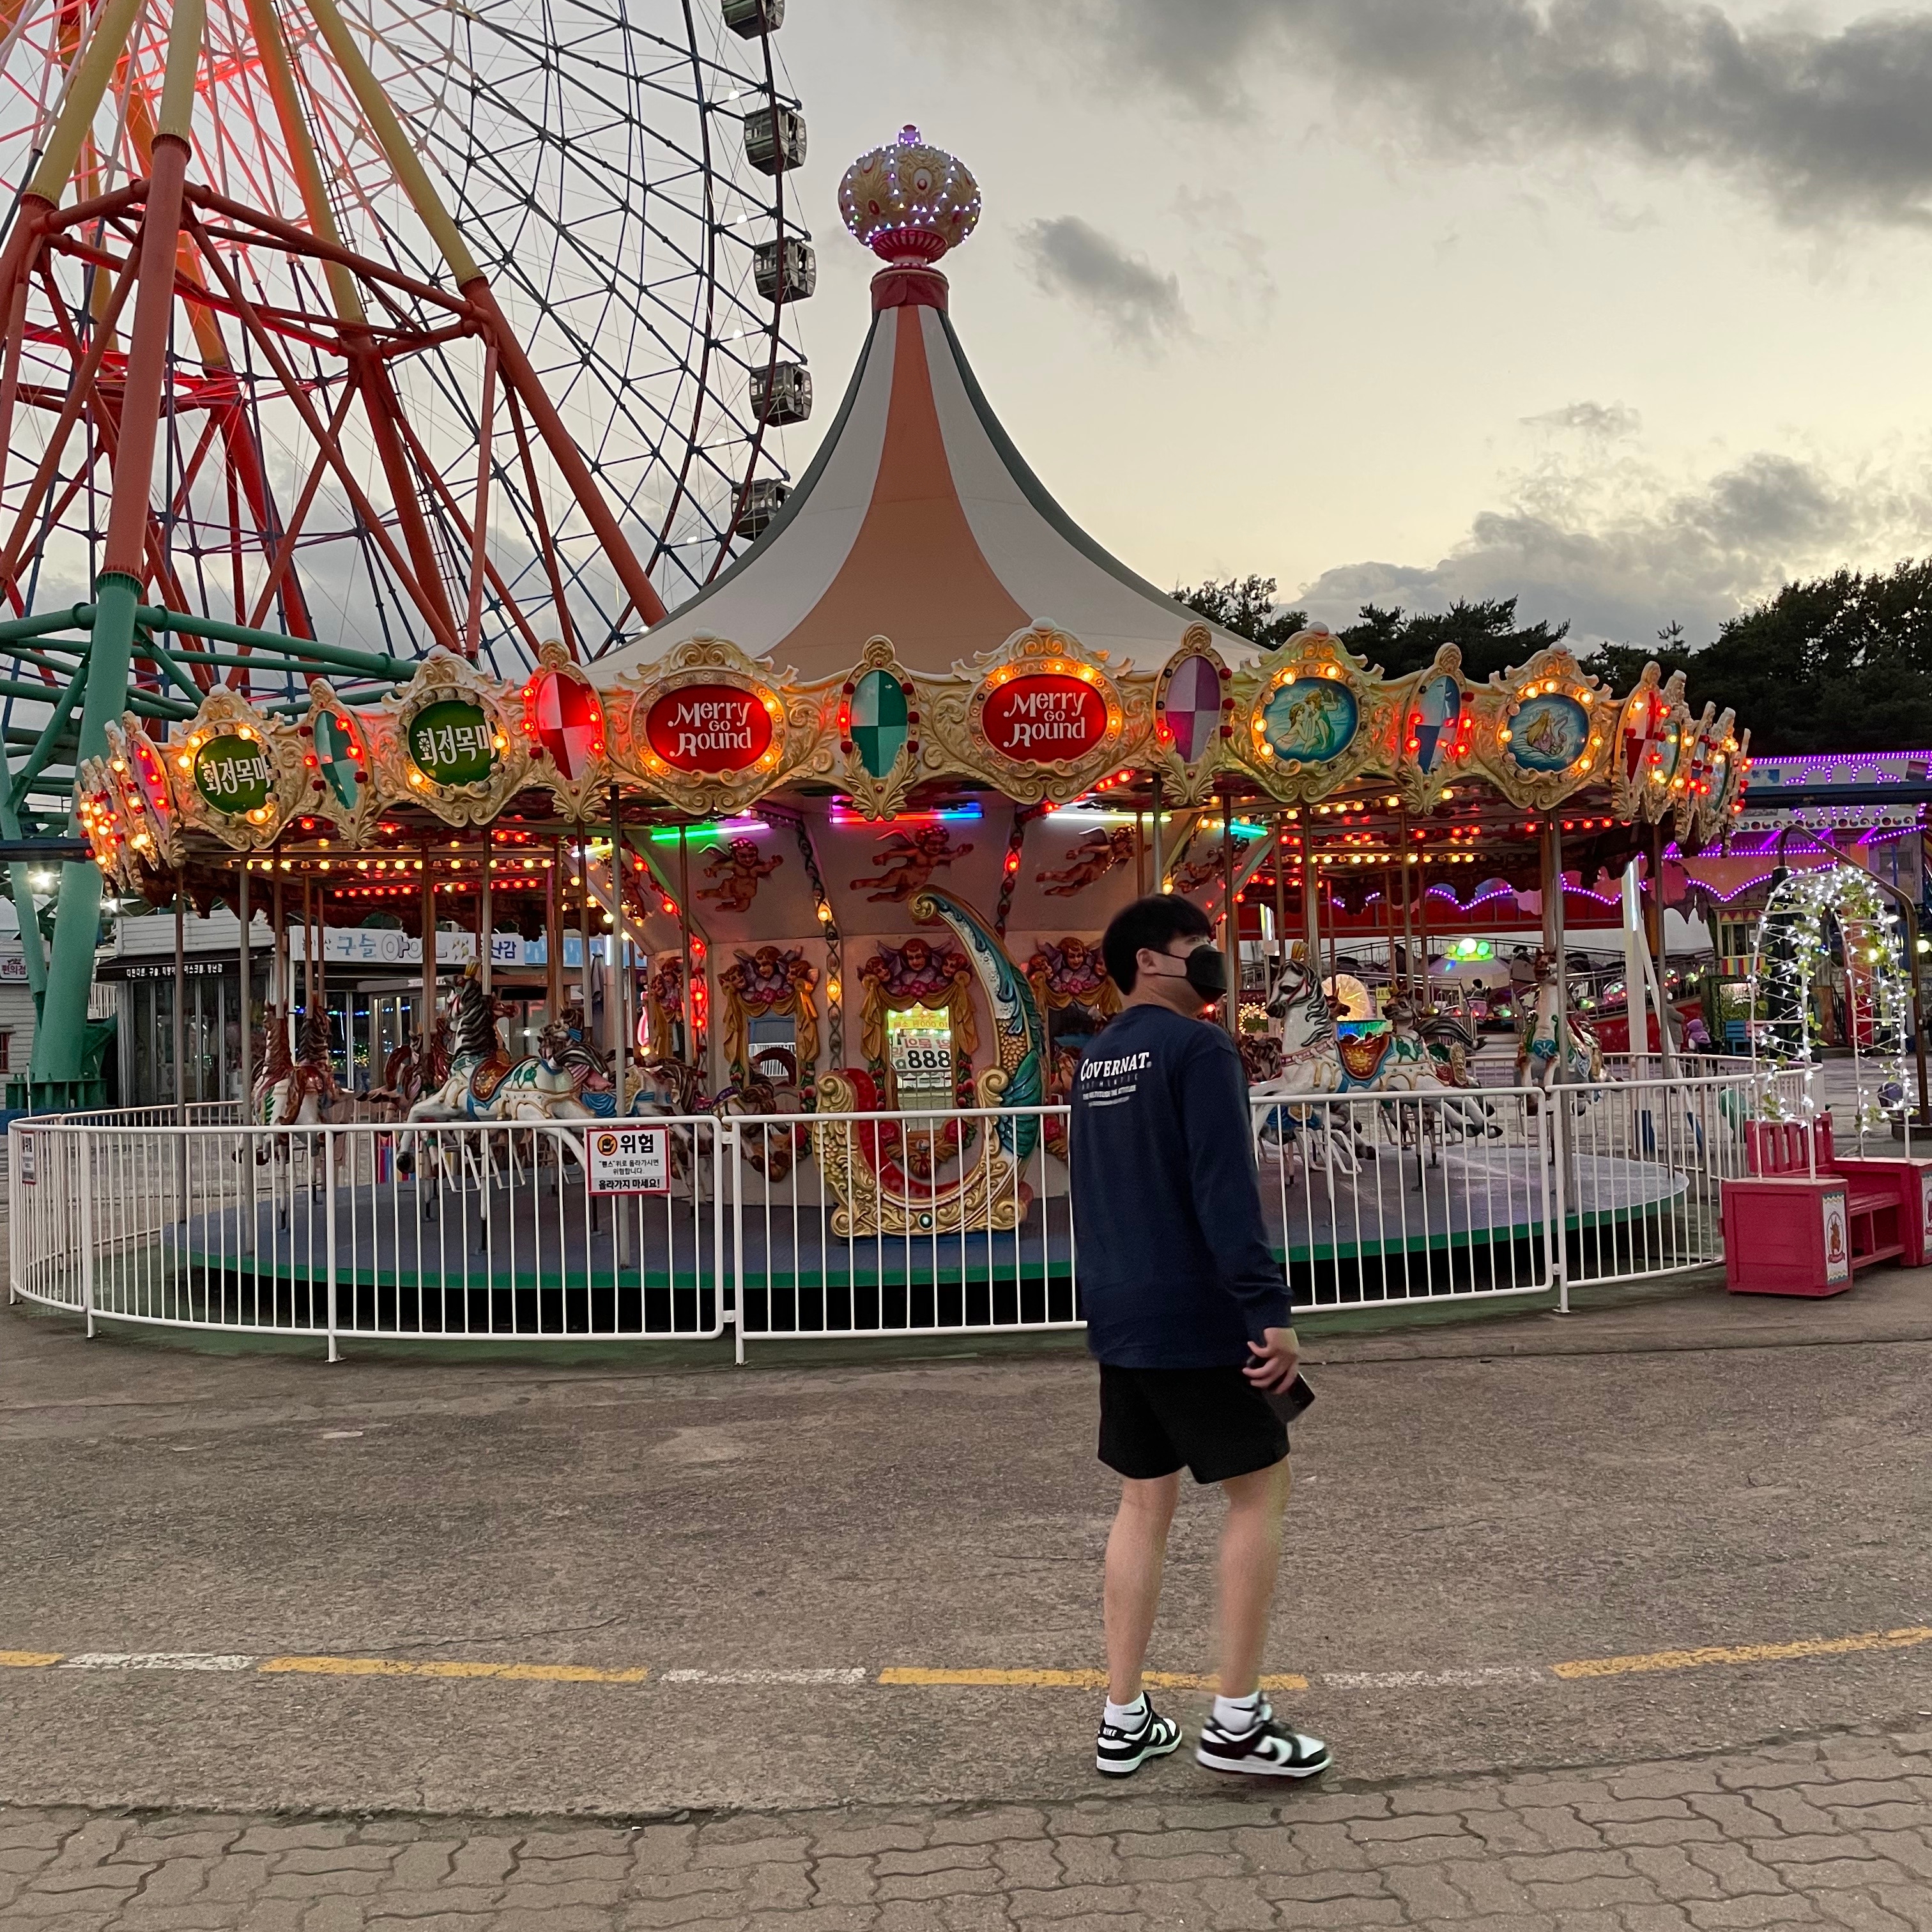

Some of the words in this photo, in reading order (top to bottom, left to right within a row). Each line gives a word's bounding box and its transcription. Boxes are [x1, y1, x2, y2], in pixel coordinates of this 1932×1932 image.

[668, 702, 753, 727] Merry
[1003, 692, 1088, 717] Merry
[1043, 710, 1066, 722] GO
[709, 720, 731, 732] GO
[1003, 716, 1085, 747] Round
[417, 719, 496, 766] 회전목마
[669, 726, 752, 757] Round
[201, 754, 271, 796] 회전목마
[337, 933, 377, 958] 구슬
[1080, 1052, 1149, 1082] COVERNAT
[620, 1133, 654, 1154] 위험
[599, 1179, 631, 1190] 올라가지
[632, 1178, 660, 1189] 마세요!
